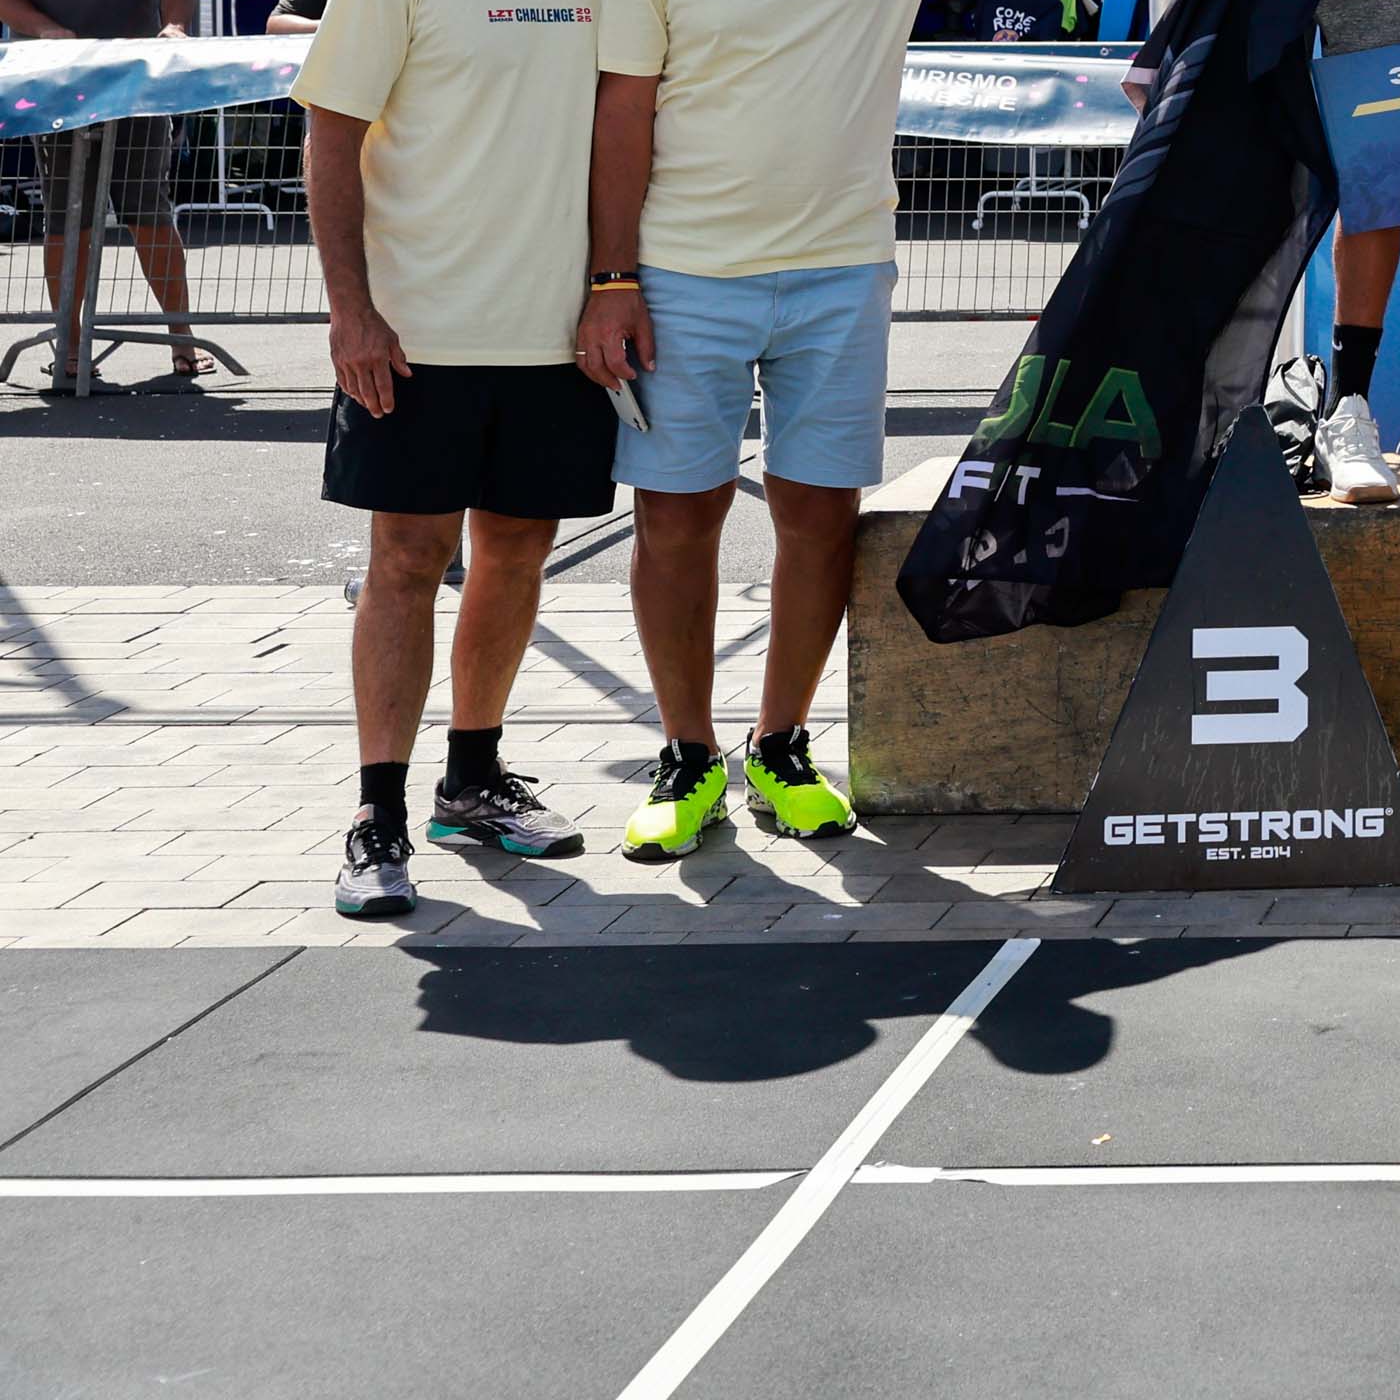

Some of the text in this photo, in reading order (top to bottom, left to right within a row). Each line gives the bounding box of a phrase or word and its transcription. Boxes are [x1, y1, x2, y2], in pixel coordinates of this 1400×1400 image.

[488, 9, 514, 17] LZT
[515, 8, 575, 22] CHALLENGE
[996, 6, 1036, 26] COME
[903, 68, 1017, 89] URISMO
[1191, 626, 1309, 745] 3
[1103, 807, 1395, 846] GETSTRONG
[1206, 845, 1291, 861] EST. 2014
